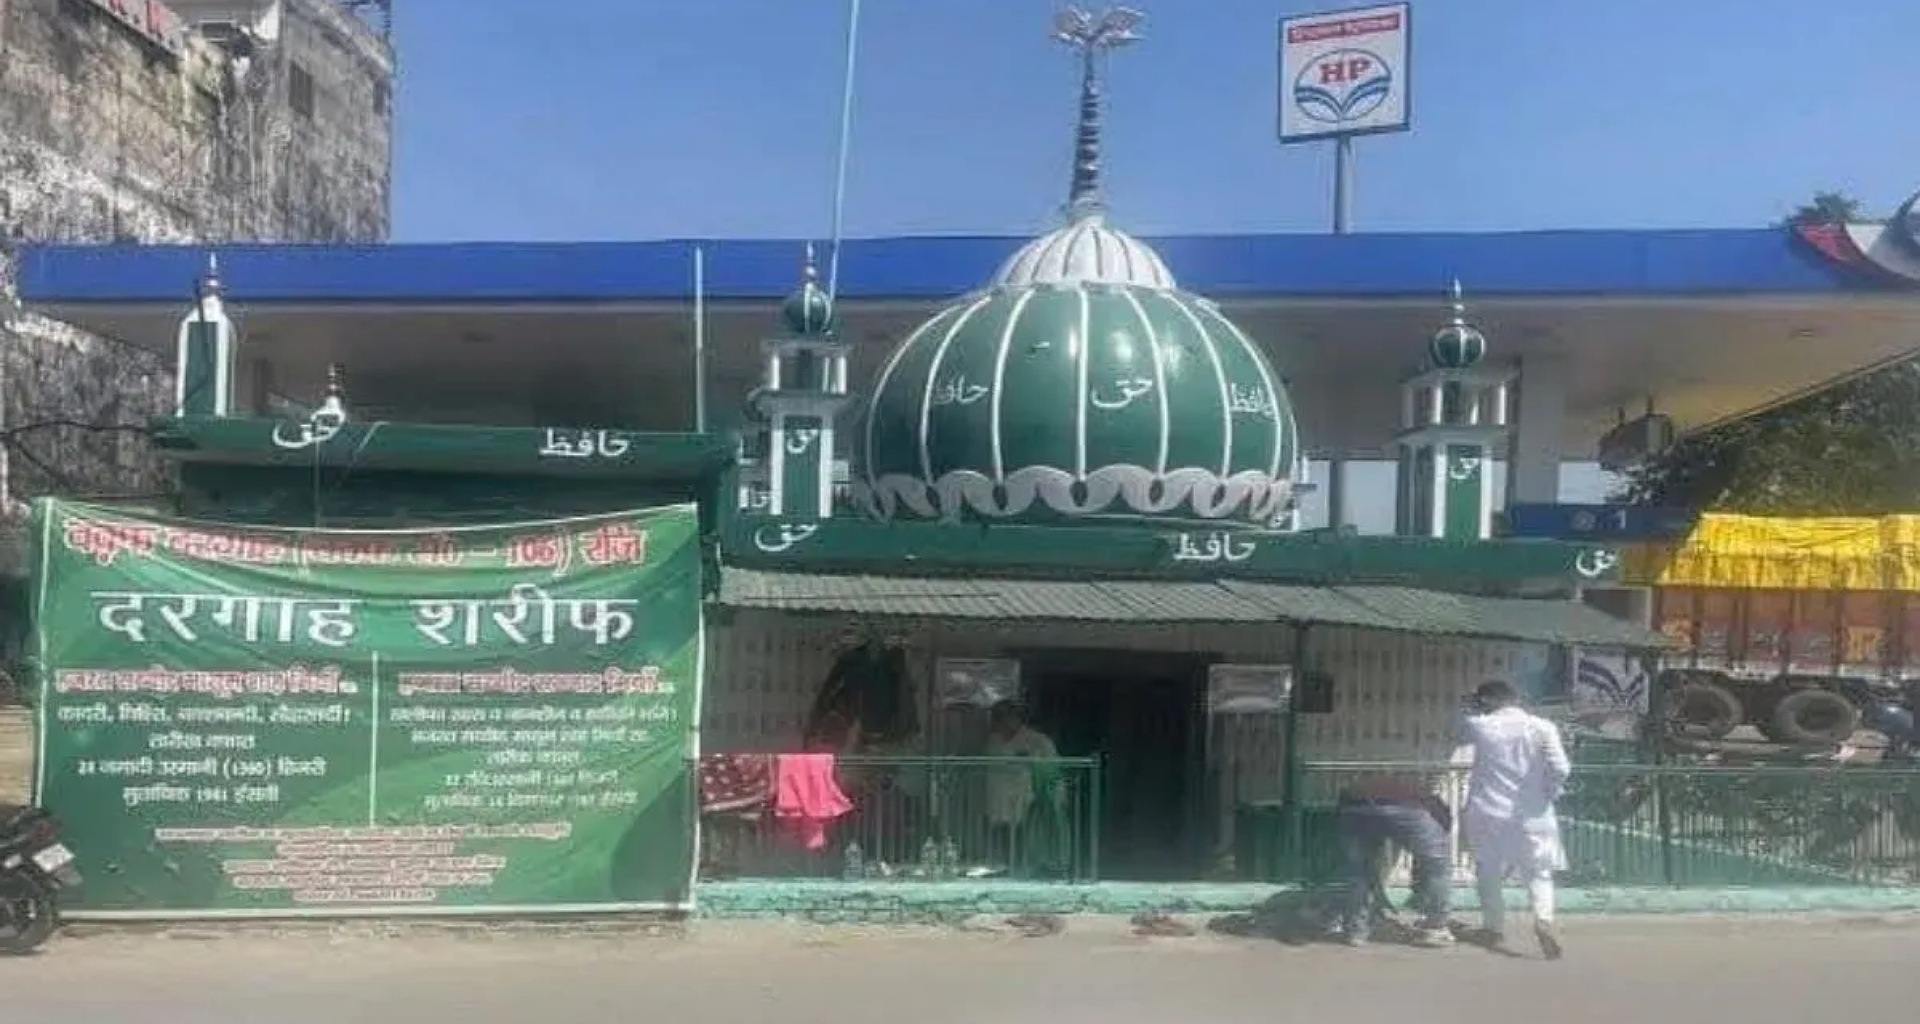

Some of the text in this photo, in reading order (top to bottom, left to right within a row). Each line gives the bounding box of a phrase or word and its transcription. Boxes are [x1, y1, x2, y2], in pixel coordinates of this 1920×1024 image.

[1319, 57, 1371, 84] HP
[1091, 378, 1153, 408] حق
[539, 427, 629, 457] حافظ
[755, 523, 817, 552] حق
[1173, 531, 1256, 560] حافظ
[90, 583, 640, 647] दरगाह शरीफ
